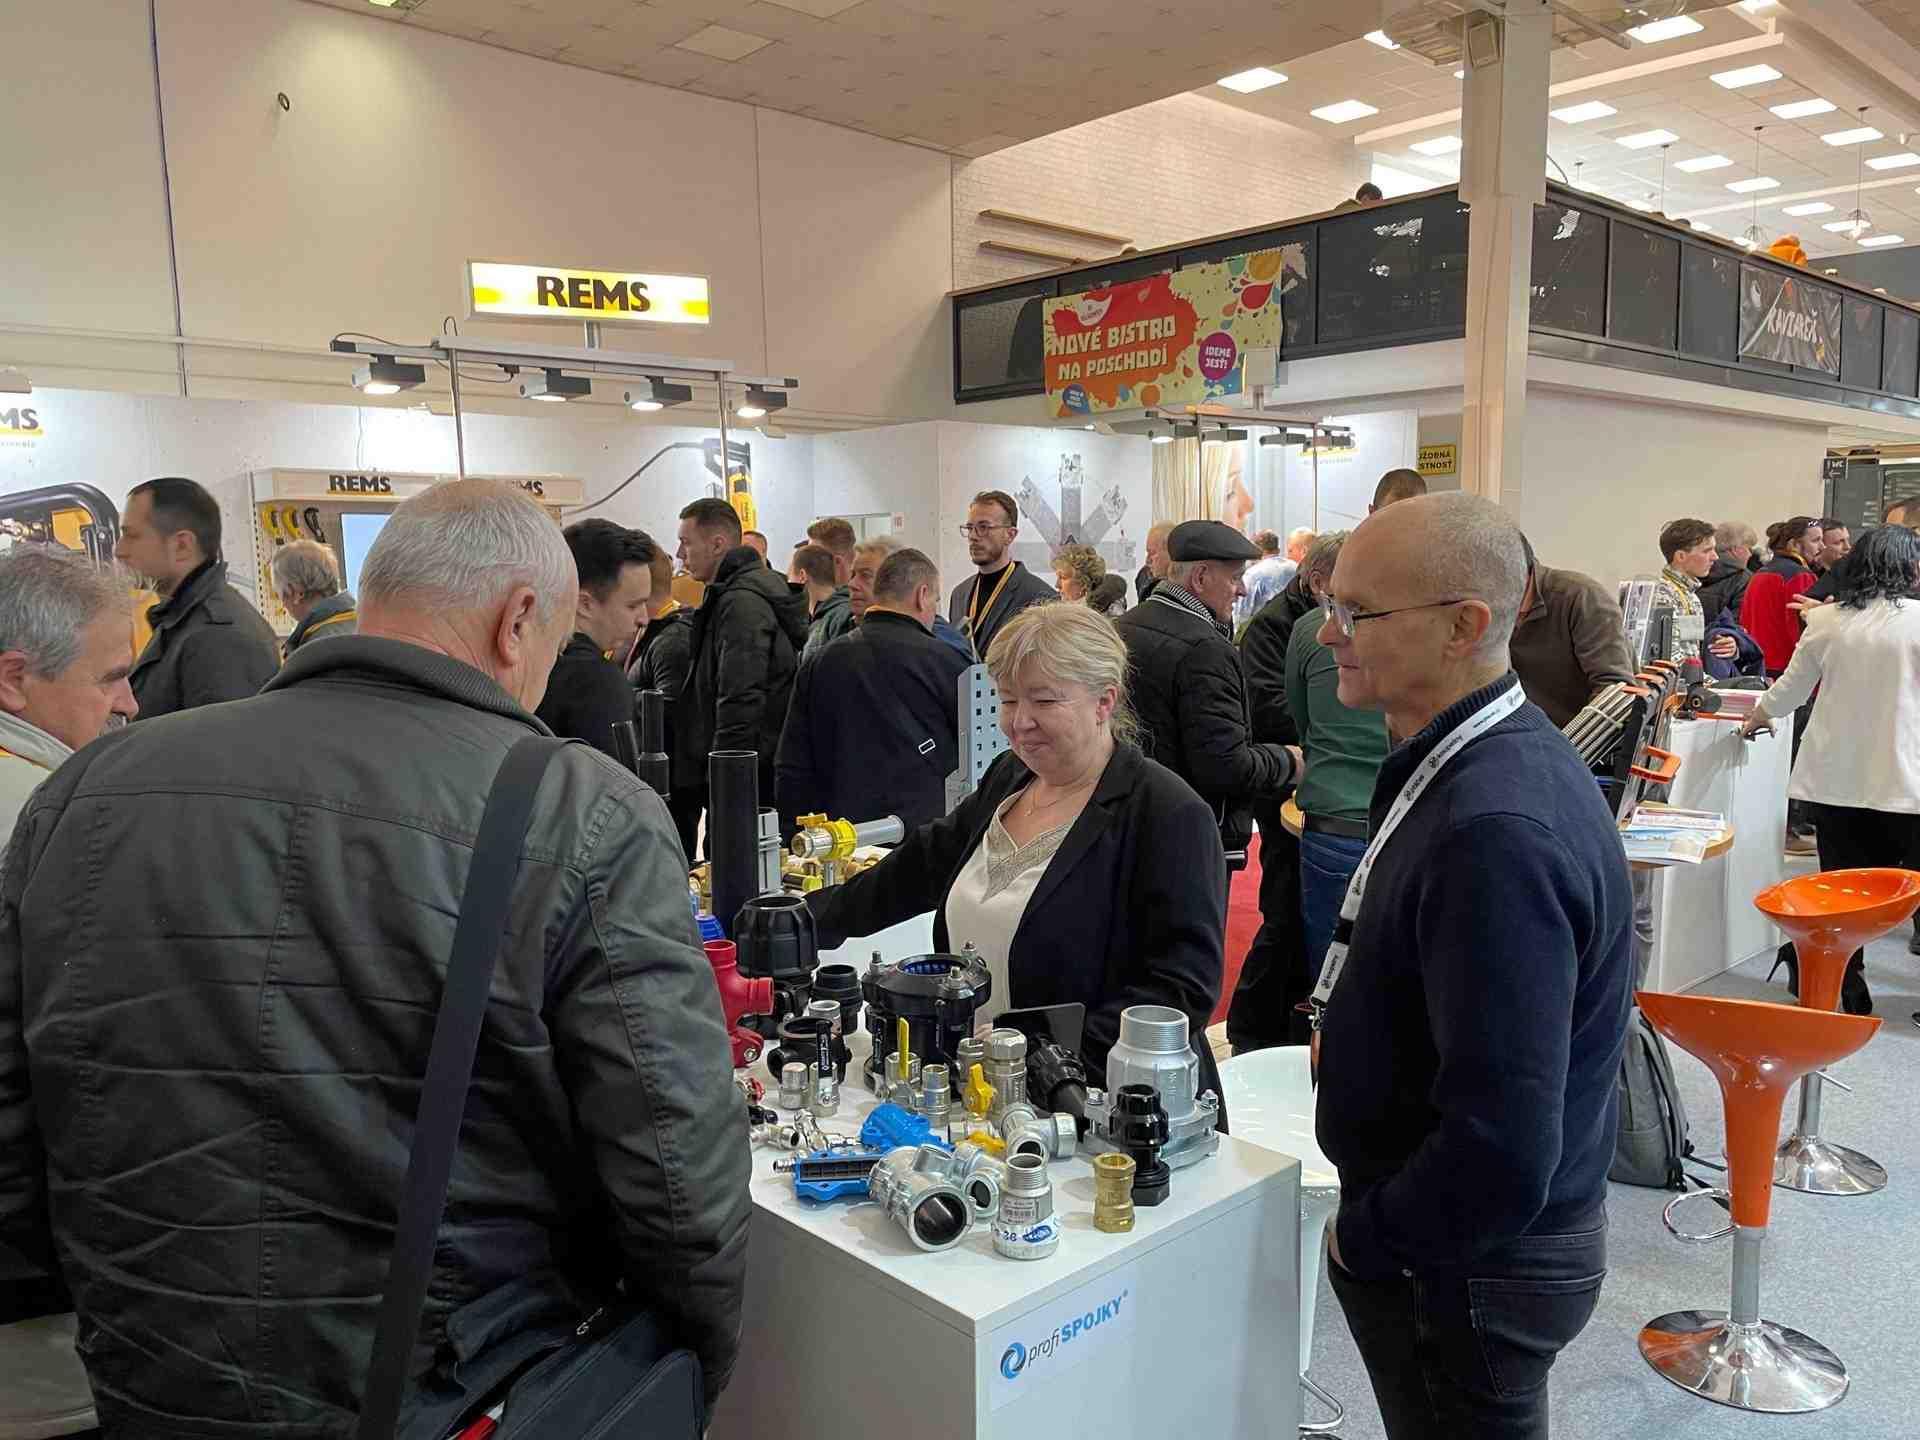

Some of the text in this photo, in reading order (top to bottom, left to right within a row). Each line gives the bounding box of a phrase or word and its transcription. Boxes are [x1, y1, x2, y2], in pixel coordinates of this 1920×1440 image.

[537, 275, 651, 312] REMS
[1052, 315, 1176, 356] NOVÉ BISTRO
[1059, 343, 1168, 380] NA POSCHODÍ
[329, 475, 392, 493] REMS
